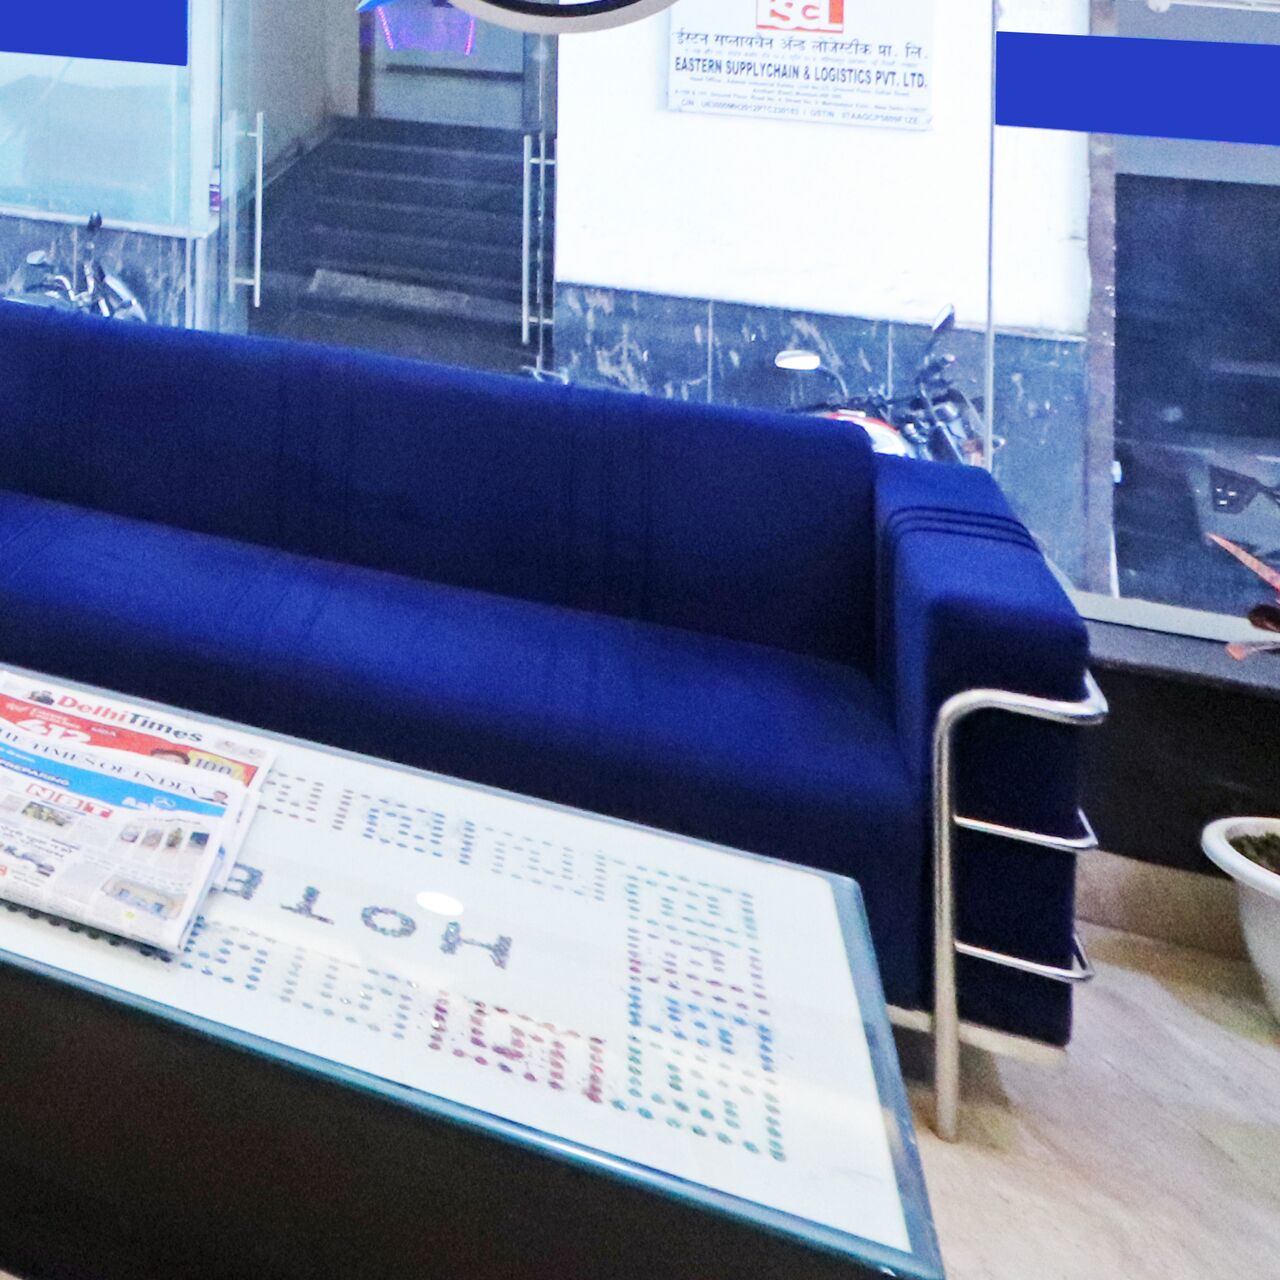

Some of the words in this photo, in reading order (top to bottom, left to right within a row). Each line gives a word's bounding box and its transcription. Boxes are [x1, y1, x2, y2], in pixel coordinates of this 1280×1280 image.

[675, 56, 722, 75] EASTERN
[726, 59, 799, 80] SUPPLYCHAIN
[803, 67, 811, 80] &
[814, 67, 871, 86] LOGISTICS
[875, 71, 900, 87] PVT.
[903, 72, 928, 89] LTD.
[31, 742, 96, 767] TIMES
[132, 769, 198, 796] INDIA
[208, 862, 512, 971] HOTE
